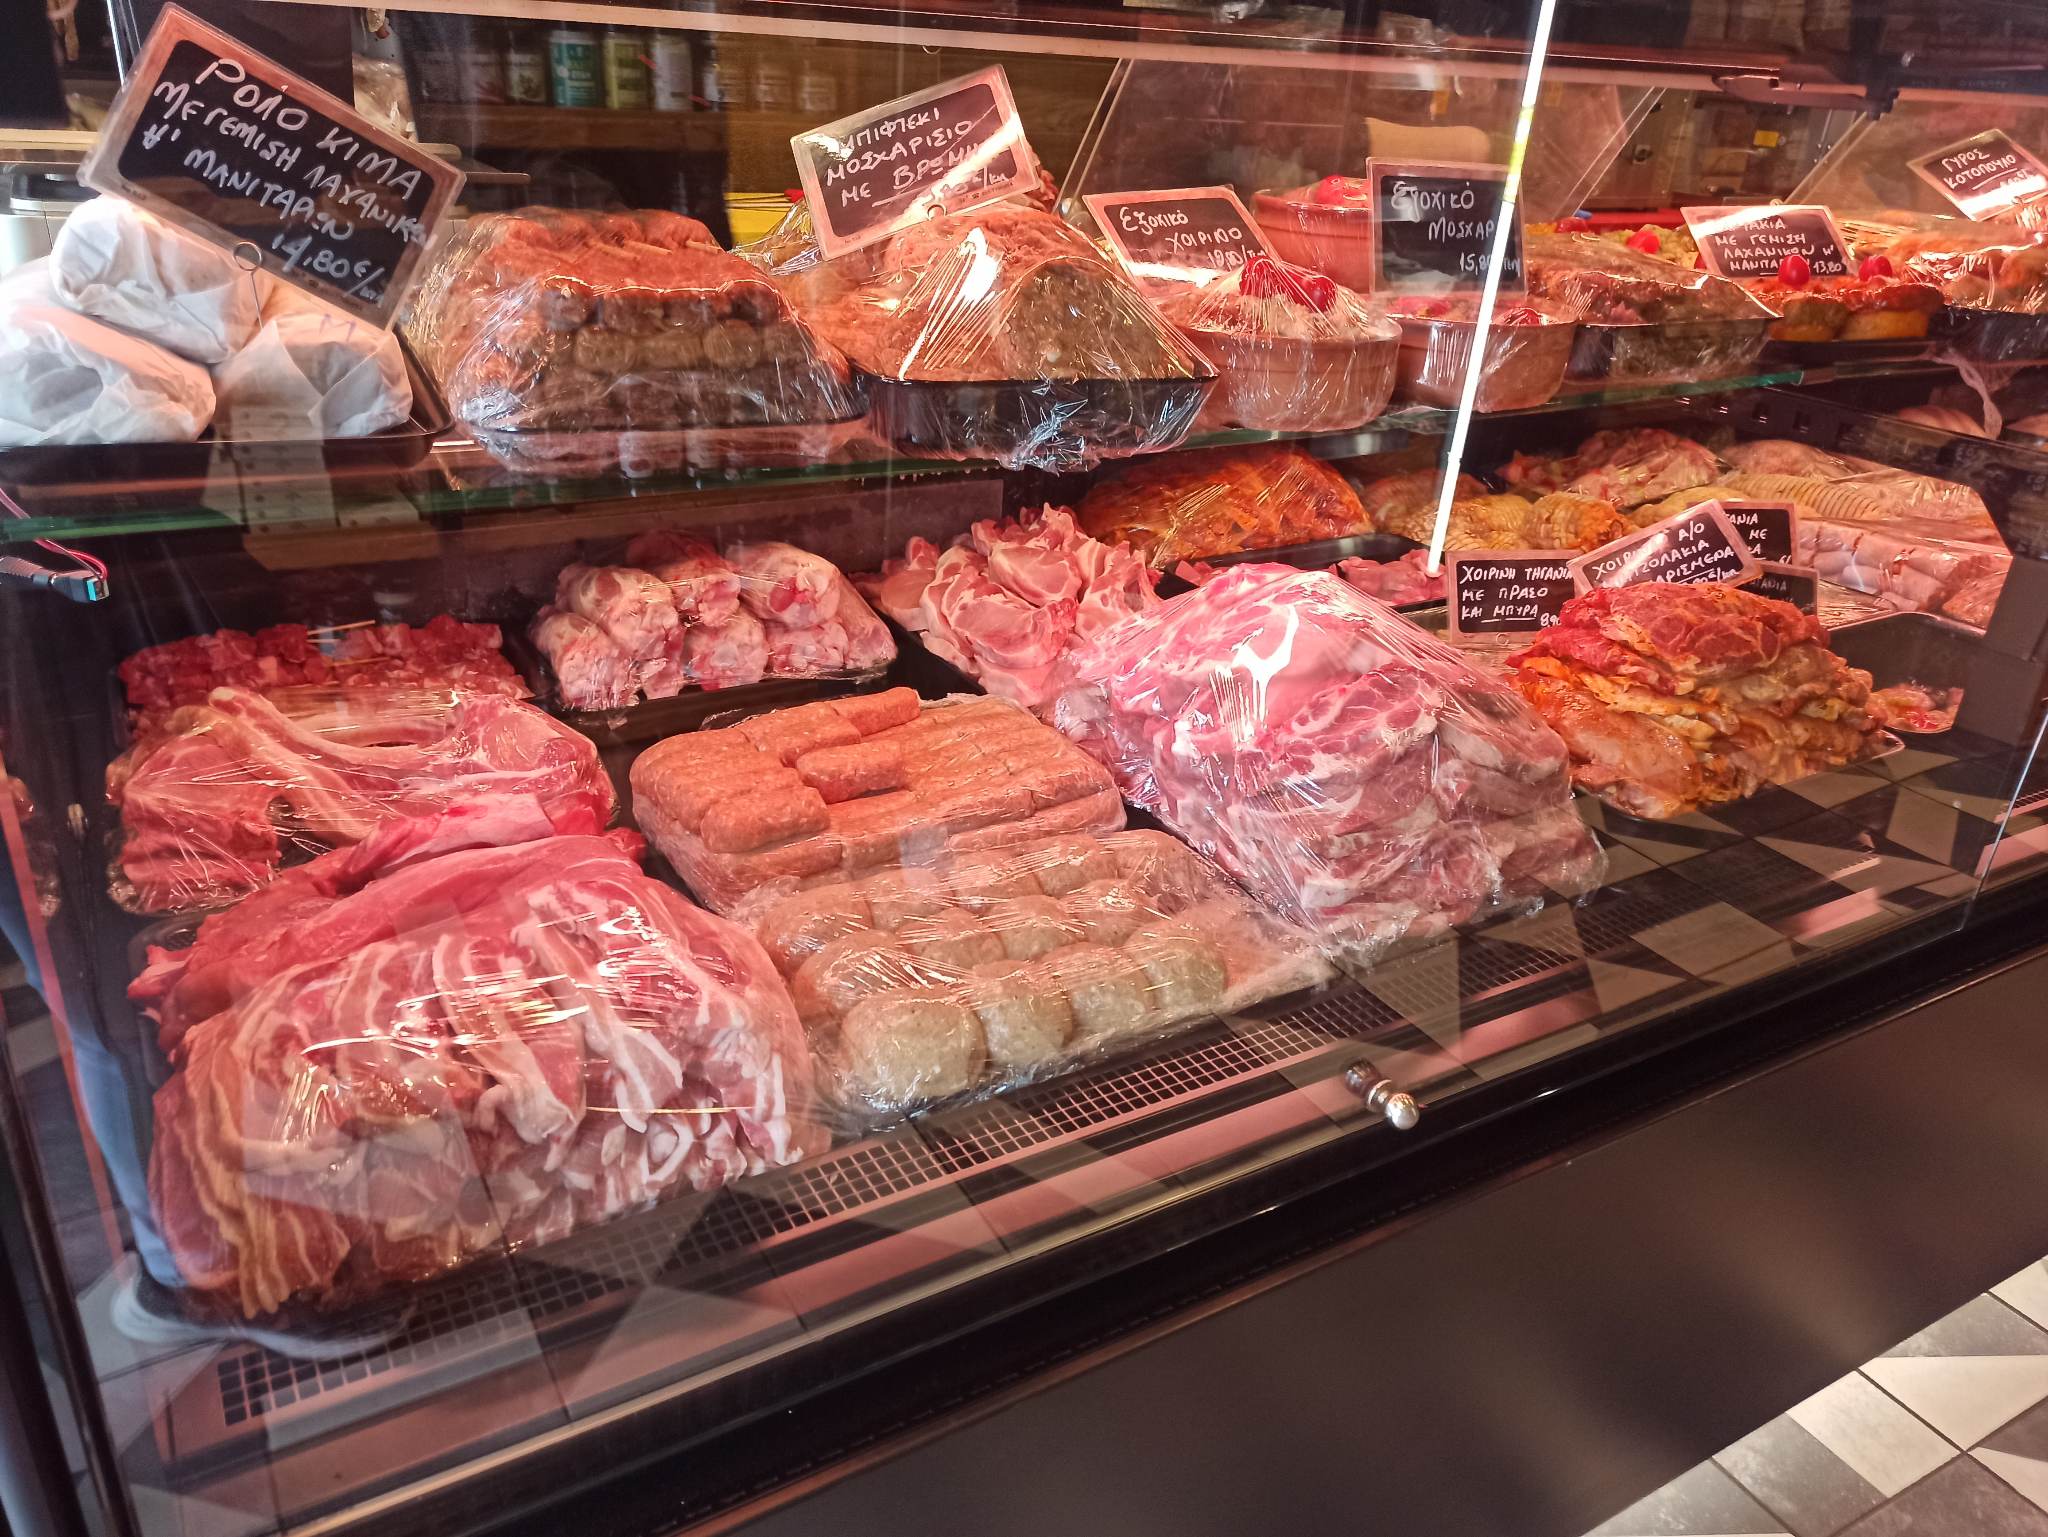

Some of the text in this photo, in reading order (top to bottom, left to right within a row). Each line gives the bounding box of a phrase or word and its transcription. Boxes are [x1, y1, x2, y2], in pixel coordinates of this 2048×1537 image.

[153, 81, 205, 121] ΜΕ
[316, 127, 422, 200] ΚΙΜΑ
[826, 120, 972, 187] ΜΟΣΧΑΡΙΣΙΟ
[1941, 148, 1990, 172] ΓΥΡΟΣ
[1943, 154, 2016, 189] ΚΟΤΟΠΟΥΛΟ
[842, 182, 872, 207] ΜΕ
[1165, 227, 1243, 253] ΧΟΙΡΙΝΟ
[1428, 216, 1496, 244] ΜΟΣΧΑΡ
[1715, 233, 1806, 246] ΜΕ ΓΕΜΙΣΗ
[1678, 520, 1705, 542] Α/Ο
[1748, 529, 1768, 539] ΜΕ
[1460, 565, 1516, 584] ΧΟΙΡΙΝΗ
[1462, 584, 1548, 601] ΜΕ ΠΡΑΣΟ
[1461, 604, 1538, 620] ΚΑΙ ΜΠΥΡΑ
